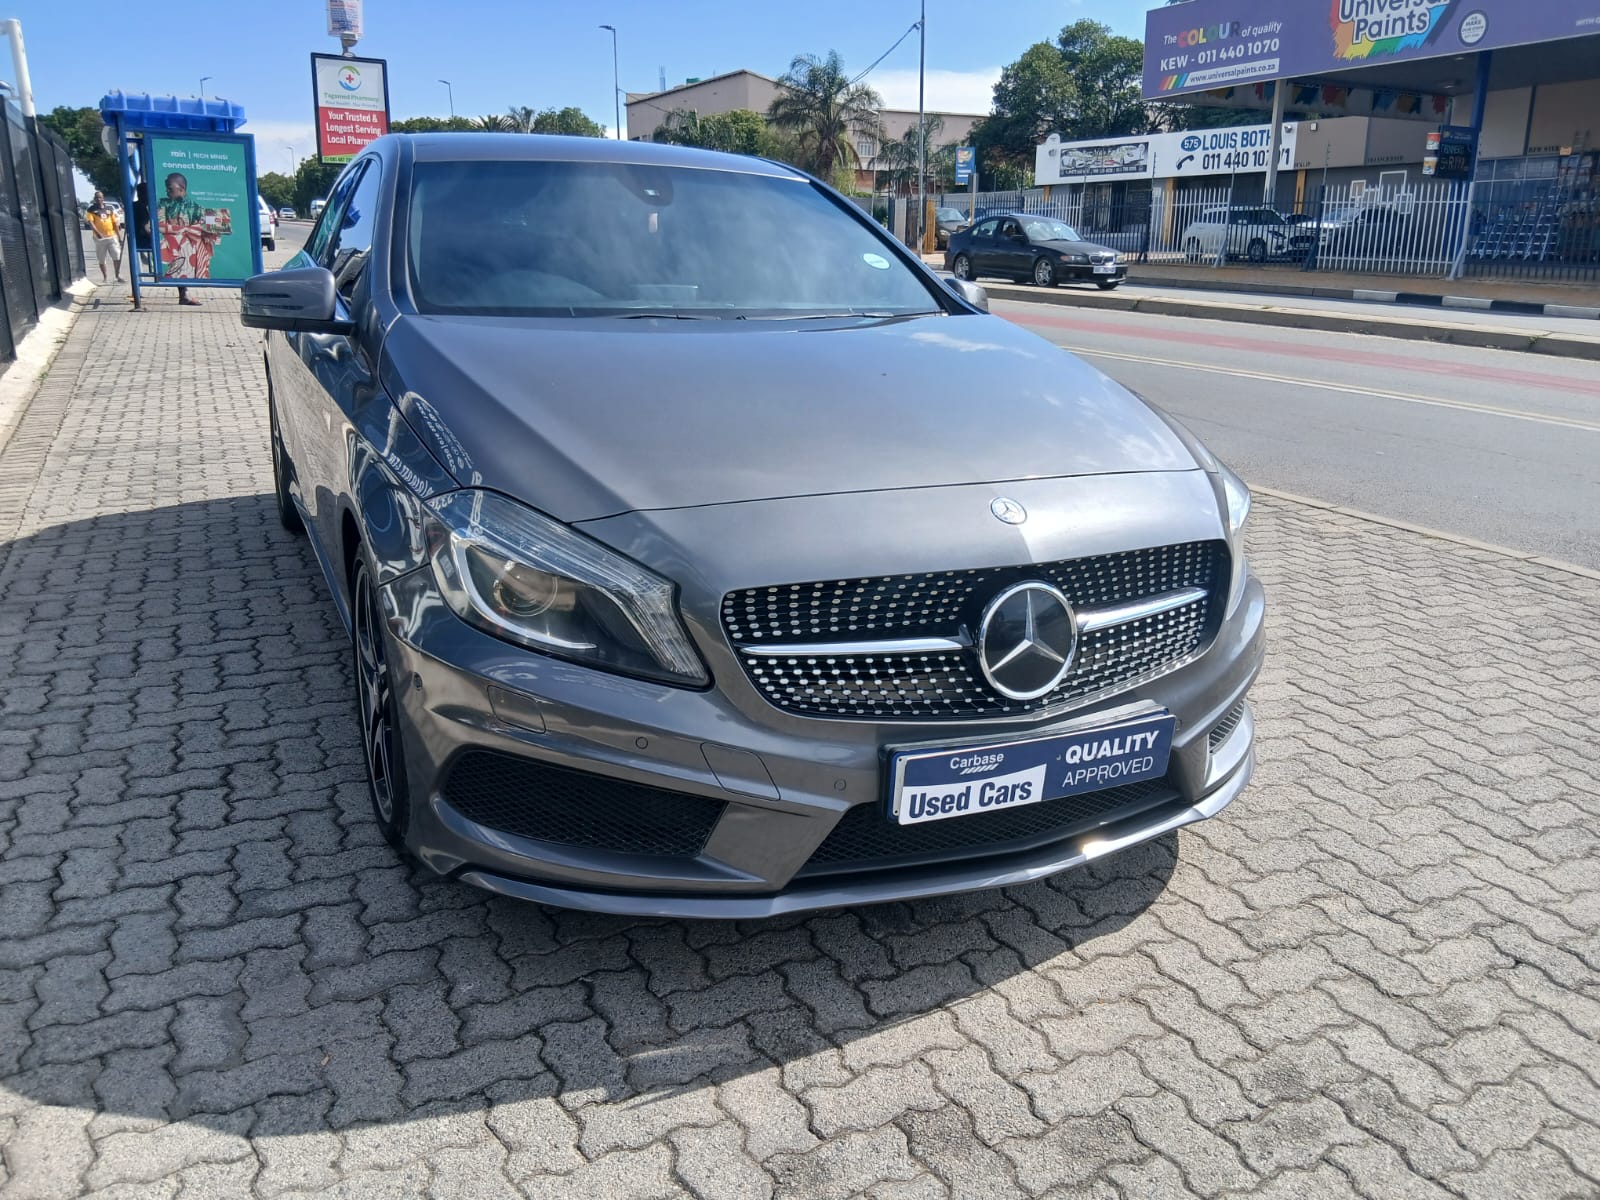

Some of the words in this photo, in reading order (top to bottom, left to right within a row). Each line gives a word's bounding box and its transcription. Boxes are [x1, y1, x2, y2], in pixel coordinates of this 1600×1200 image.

[1164, 34, 1177, 46] The
[1178, 21, 1240, 48] COLOUR
[1241, 26, 1251, 38] of
[1252, 21, 1282, 38] quality
[1355, 10, 1428, 41] Paints
[1160, 54, 1188, 71] KEW
[1198, 50, 1217, 65] 011
[1219, 44, 1244, 60] 440
[1190, 63, 1276, 83] www.universalpaints.co.za
[328, 111, 344, 121] Your
[344, 112, 371, 123] Trusted
[372, 114, 378, 123] &
[326, 122, 354, 134] Longest
[355, 124, 382, 137] Serving
[328, 134, 346, 144] Local
[347, 135, 371, 145] Pharm
[1184, 139, 1199, 149] 575
[1202, 132, 1238, 151] LOUIS
[162, 162, 195, 170] connect
[196, 163, 238, 174] beautifully
[1202, 153, 1221, 170] 011
[1223, 151, 1249, 169] 440
[1065, 730, 1160, 765] QUALITY
[950, 752, 1005, 770] Carbase
[1062, 756, 1154, 788] APPROVED
[909, 786, 972, 819] Used
[978, 779, 1033, 807] Cars
